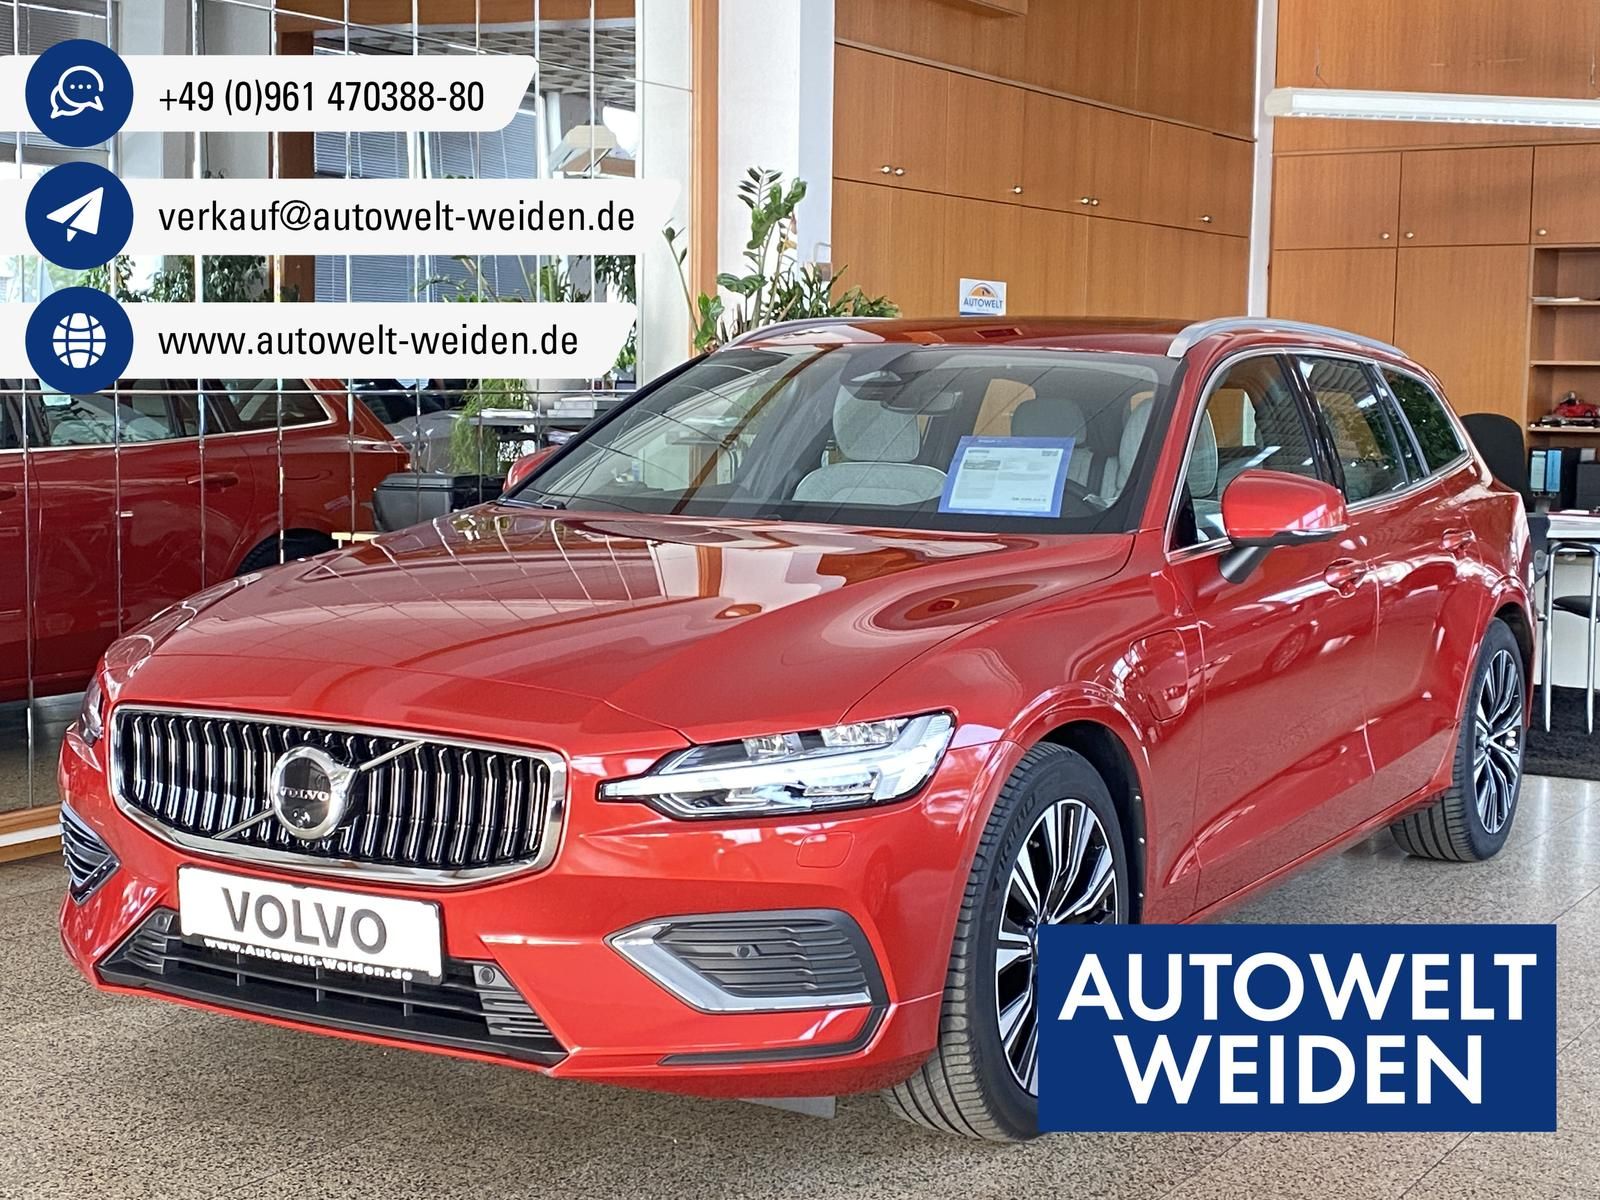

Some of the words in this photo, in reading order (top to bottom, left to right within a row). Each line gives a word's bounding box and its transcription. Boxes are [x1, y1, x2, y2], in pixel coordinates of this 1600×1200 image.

[963, 298, 1003, 309] AUTOWELT
[279, 786, 330, 802] VOLVO
[221, 886, 388, 955] VOLVO
